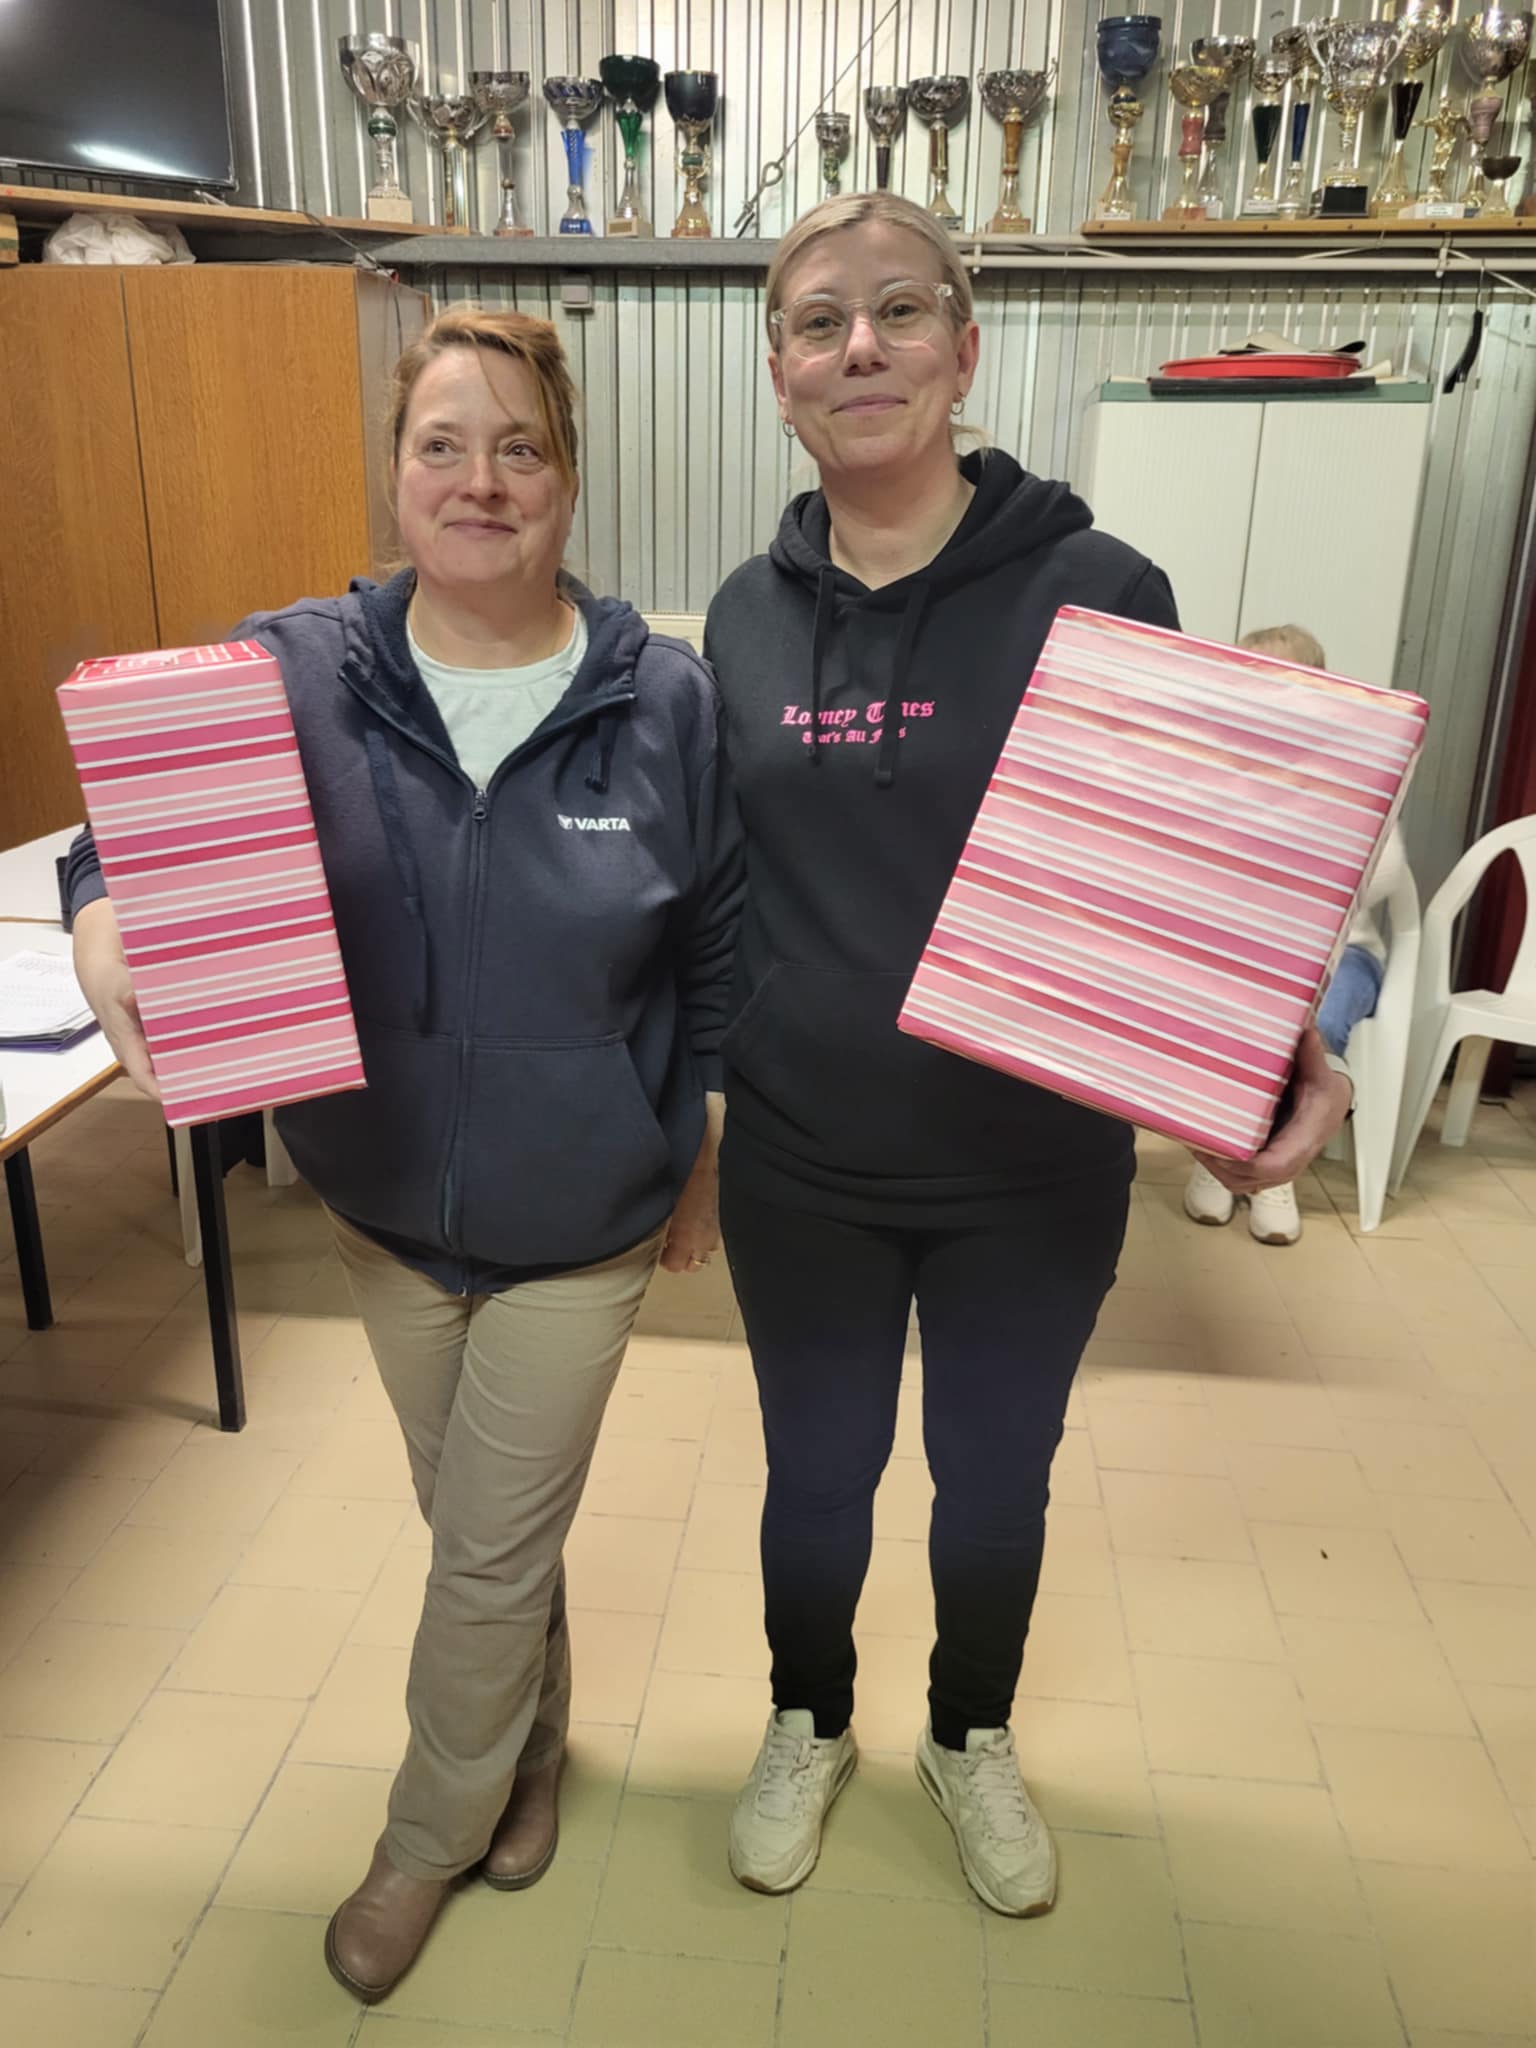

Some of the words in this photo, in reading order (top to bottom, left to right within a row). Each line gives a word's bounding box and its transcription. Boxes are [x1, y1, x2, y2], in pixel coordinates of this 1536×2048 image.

[781, 704, 858, 728] Loney
[864, 700, 936, 724] Tes
[574, 816, 631, 832] VARTA
